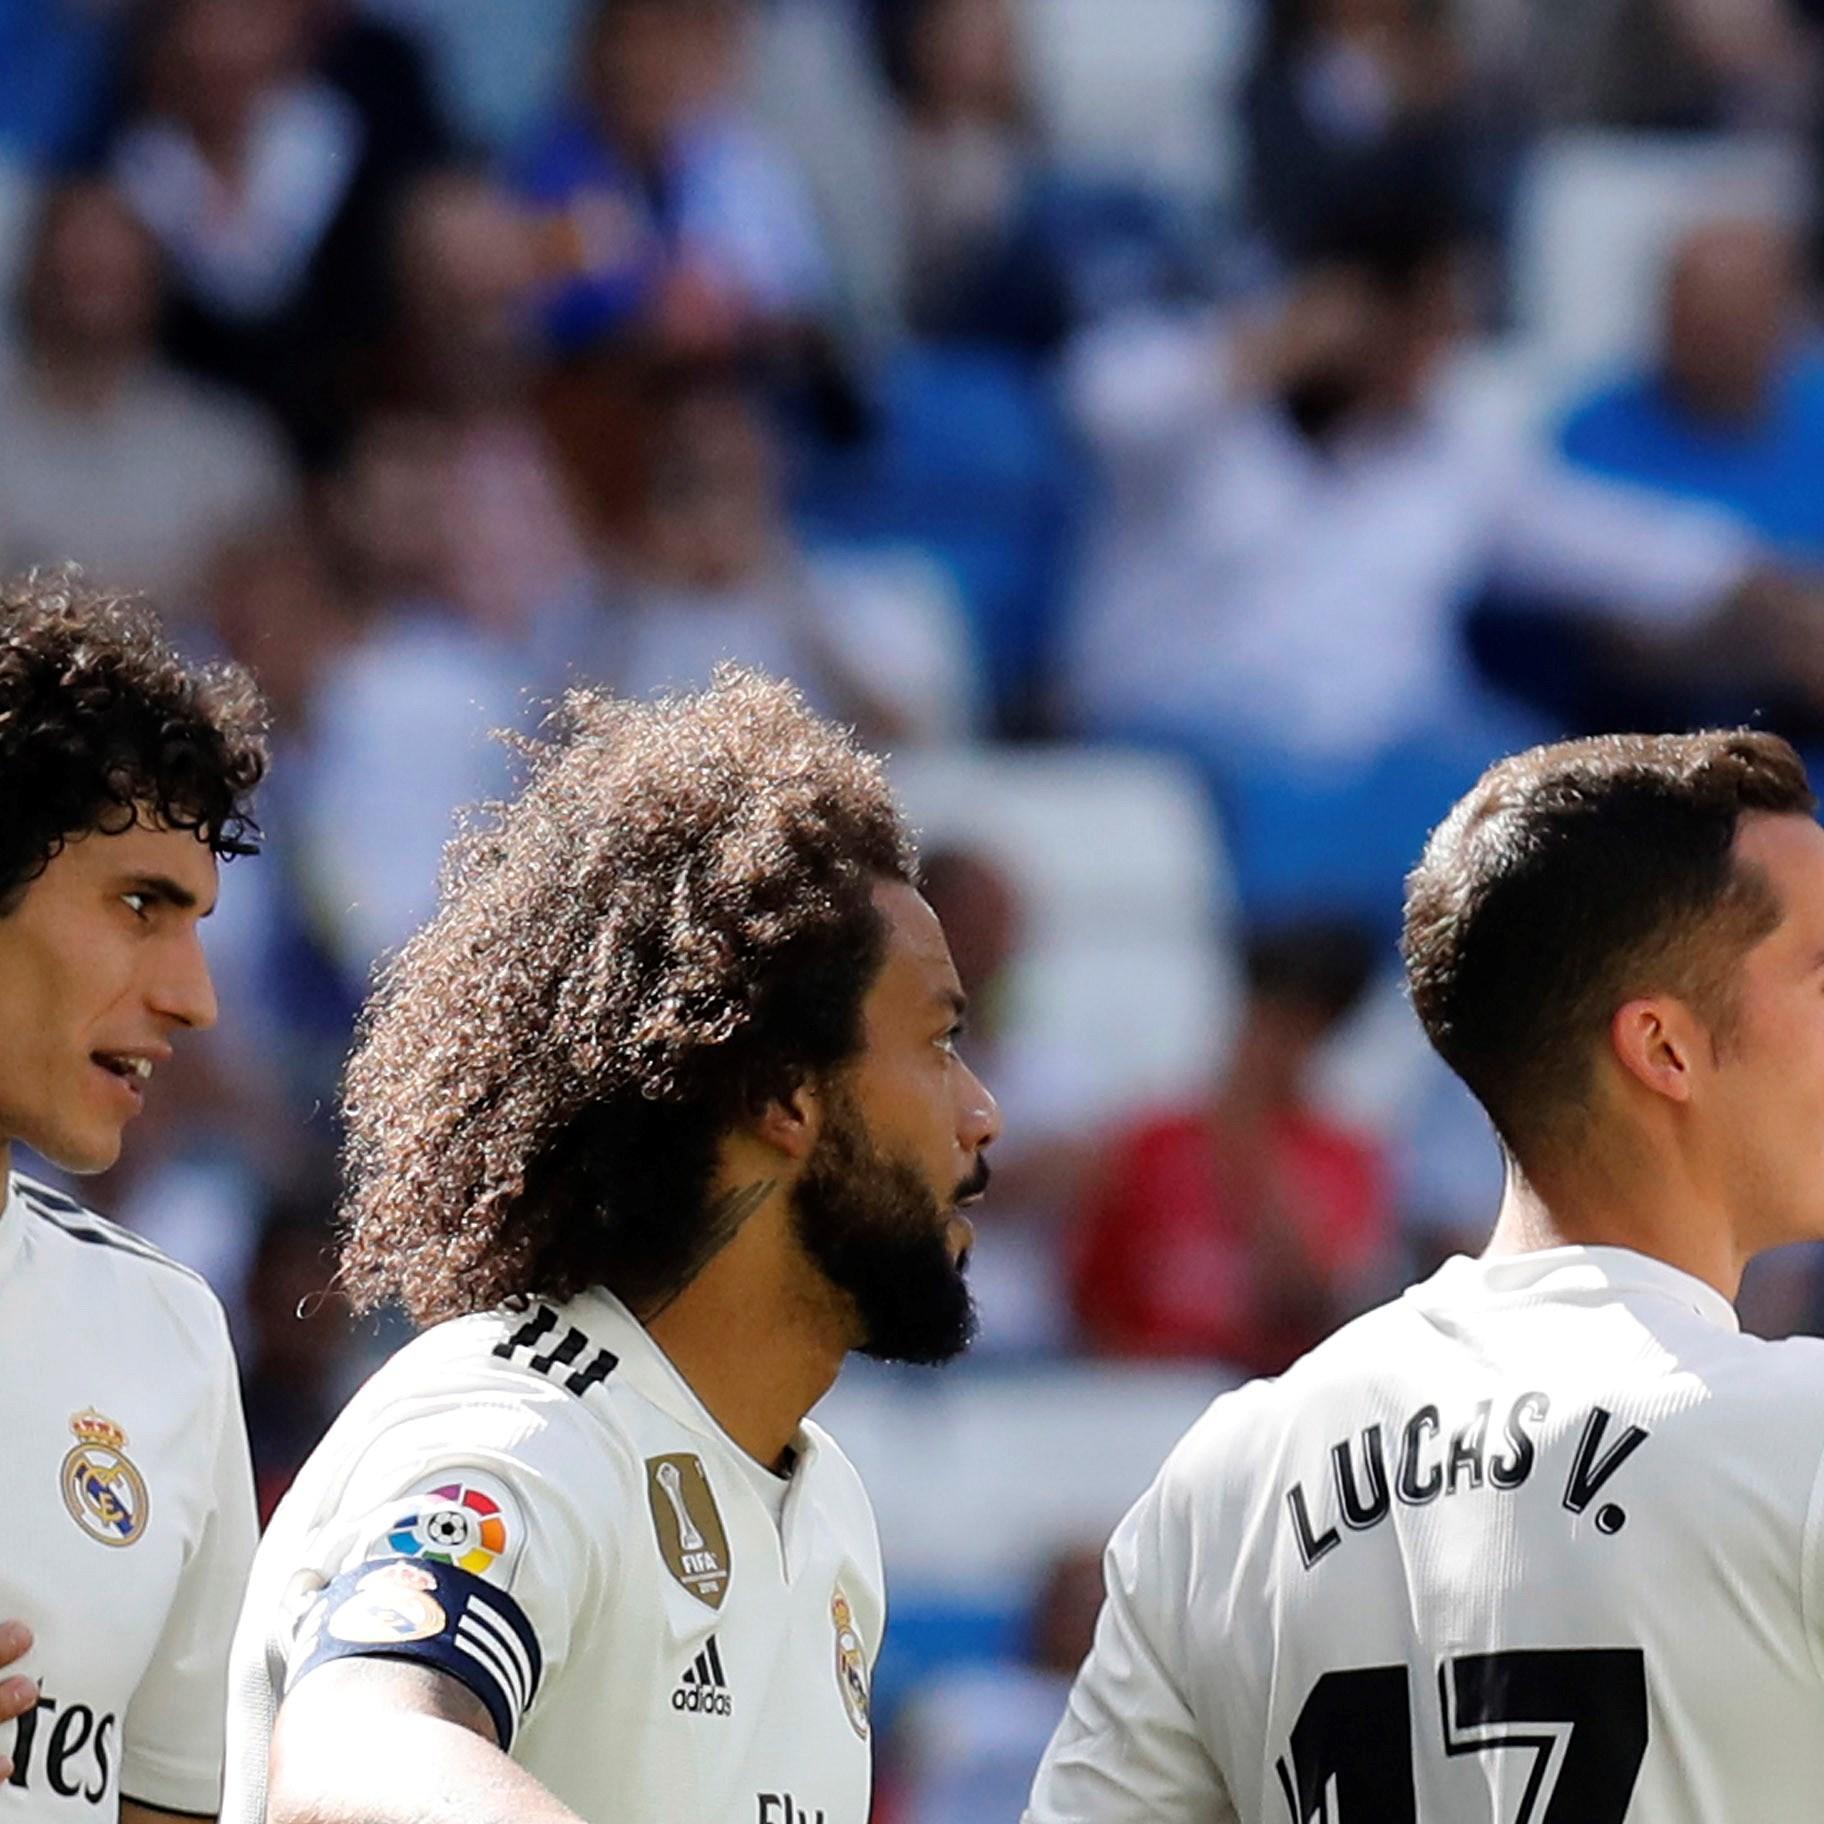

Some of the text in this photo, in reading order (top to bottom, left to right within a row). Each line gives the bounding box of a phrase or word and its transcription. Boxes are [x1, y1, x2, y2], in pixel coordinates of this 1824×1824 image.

[1285, 1391, 1649, 1570] LUCAS V.
[681, 1551, 718, 1575] FIFA
[672, 1685, 732, 1717] adidas
